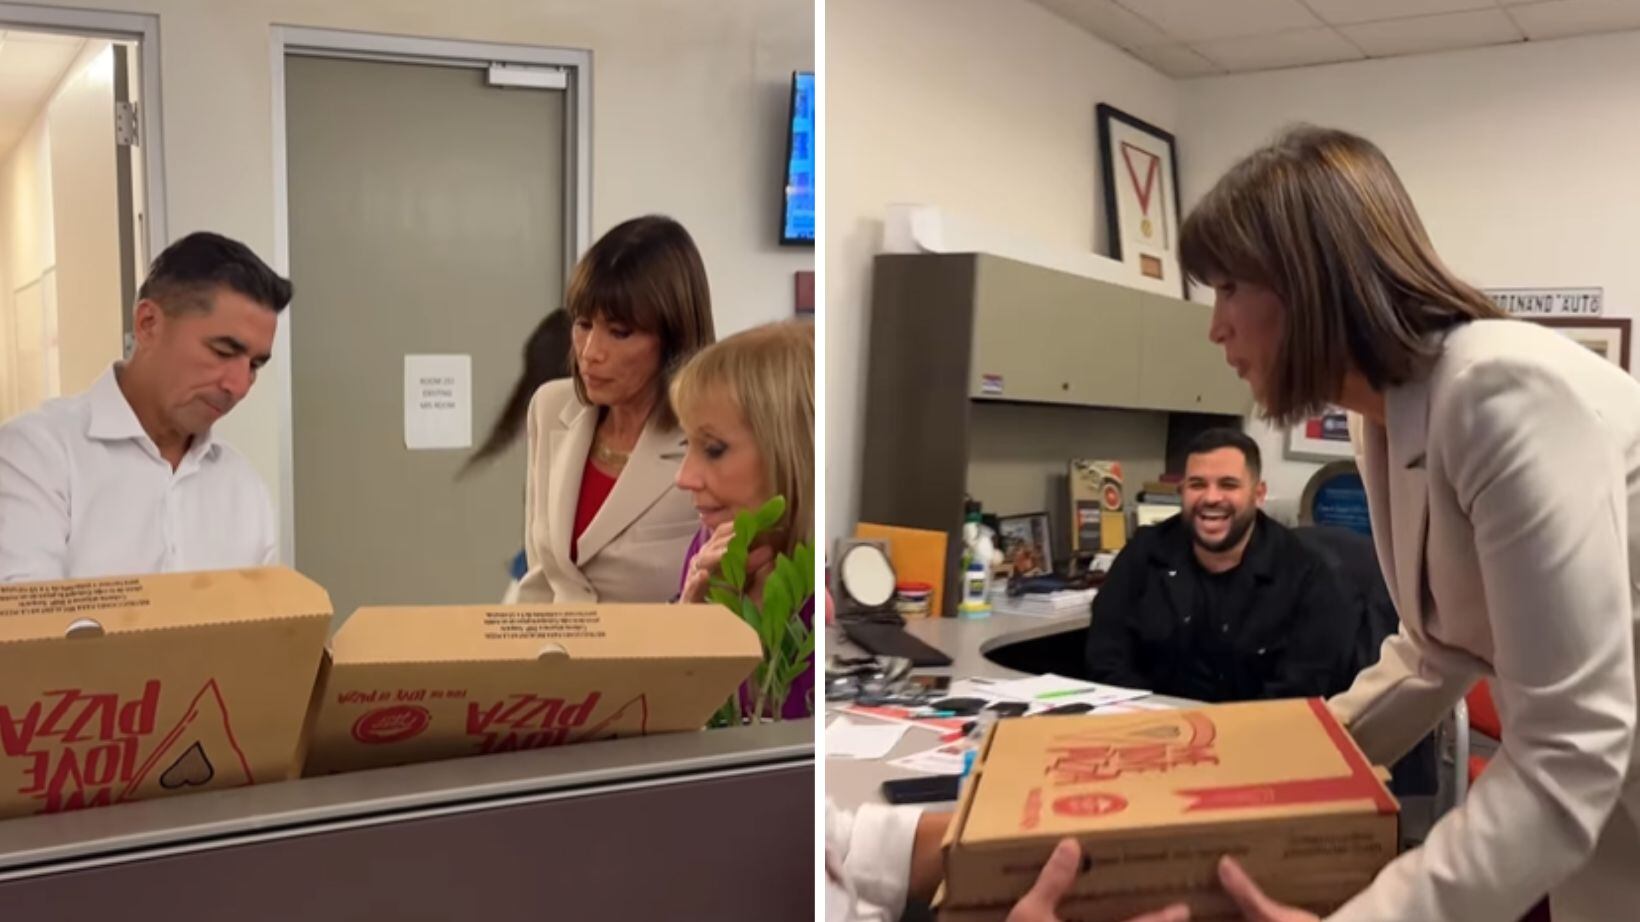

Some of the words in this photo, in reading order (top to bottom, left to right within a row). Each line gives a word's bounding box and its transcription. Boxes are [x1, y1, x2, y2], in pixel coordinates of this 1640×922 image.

[0, 680, 161, 757] PIZZA
[466, 692, 602, 737] PIZZA
[18, 737, 139, 795] LOVE
